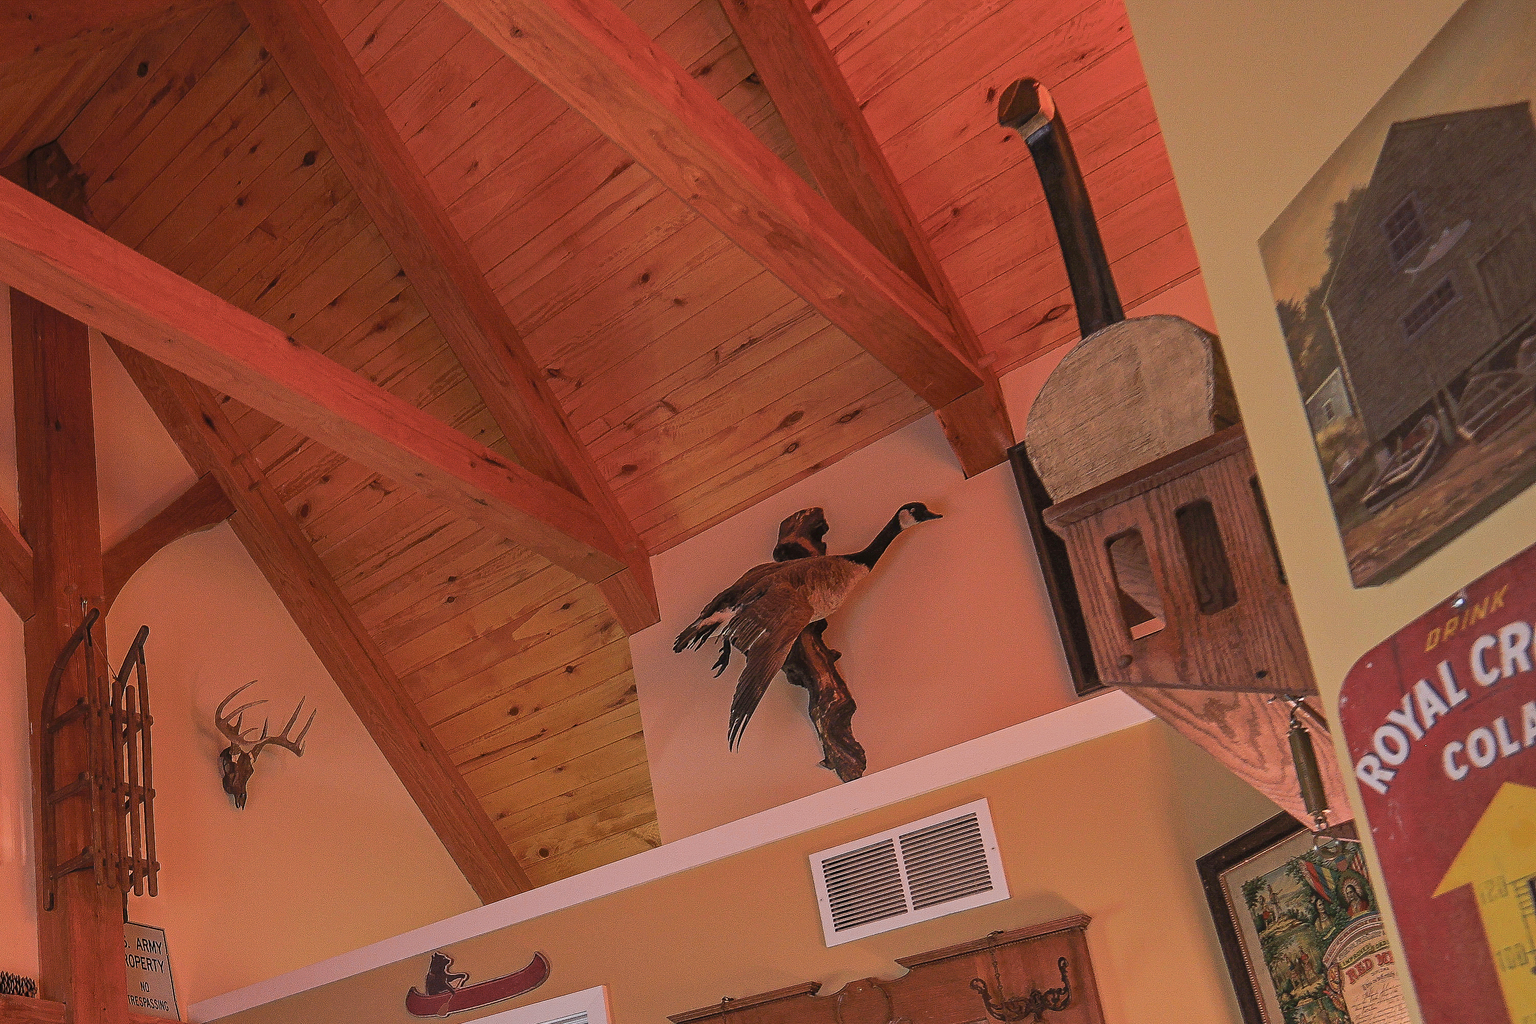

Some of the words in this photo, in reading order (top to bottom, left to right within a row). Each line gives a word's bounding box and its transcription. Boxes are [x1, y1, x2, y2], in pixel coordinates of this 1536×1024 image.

[1424, 584, 1509, 653] DRINK
[1356, 660, 1470, 795] ROYAL
[1470, 621, 1536, 688] CR
[136, 937, 162, 955] ARMY
[1346, 958, 1374, 985] RED
[140, 981, 150, 993] NO
[128, 994, 170, 1012] TRESPASSING
